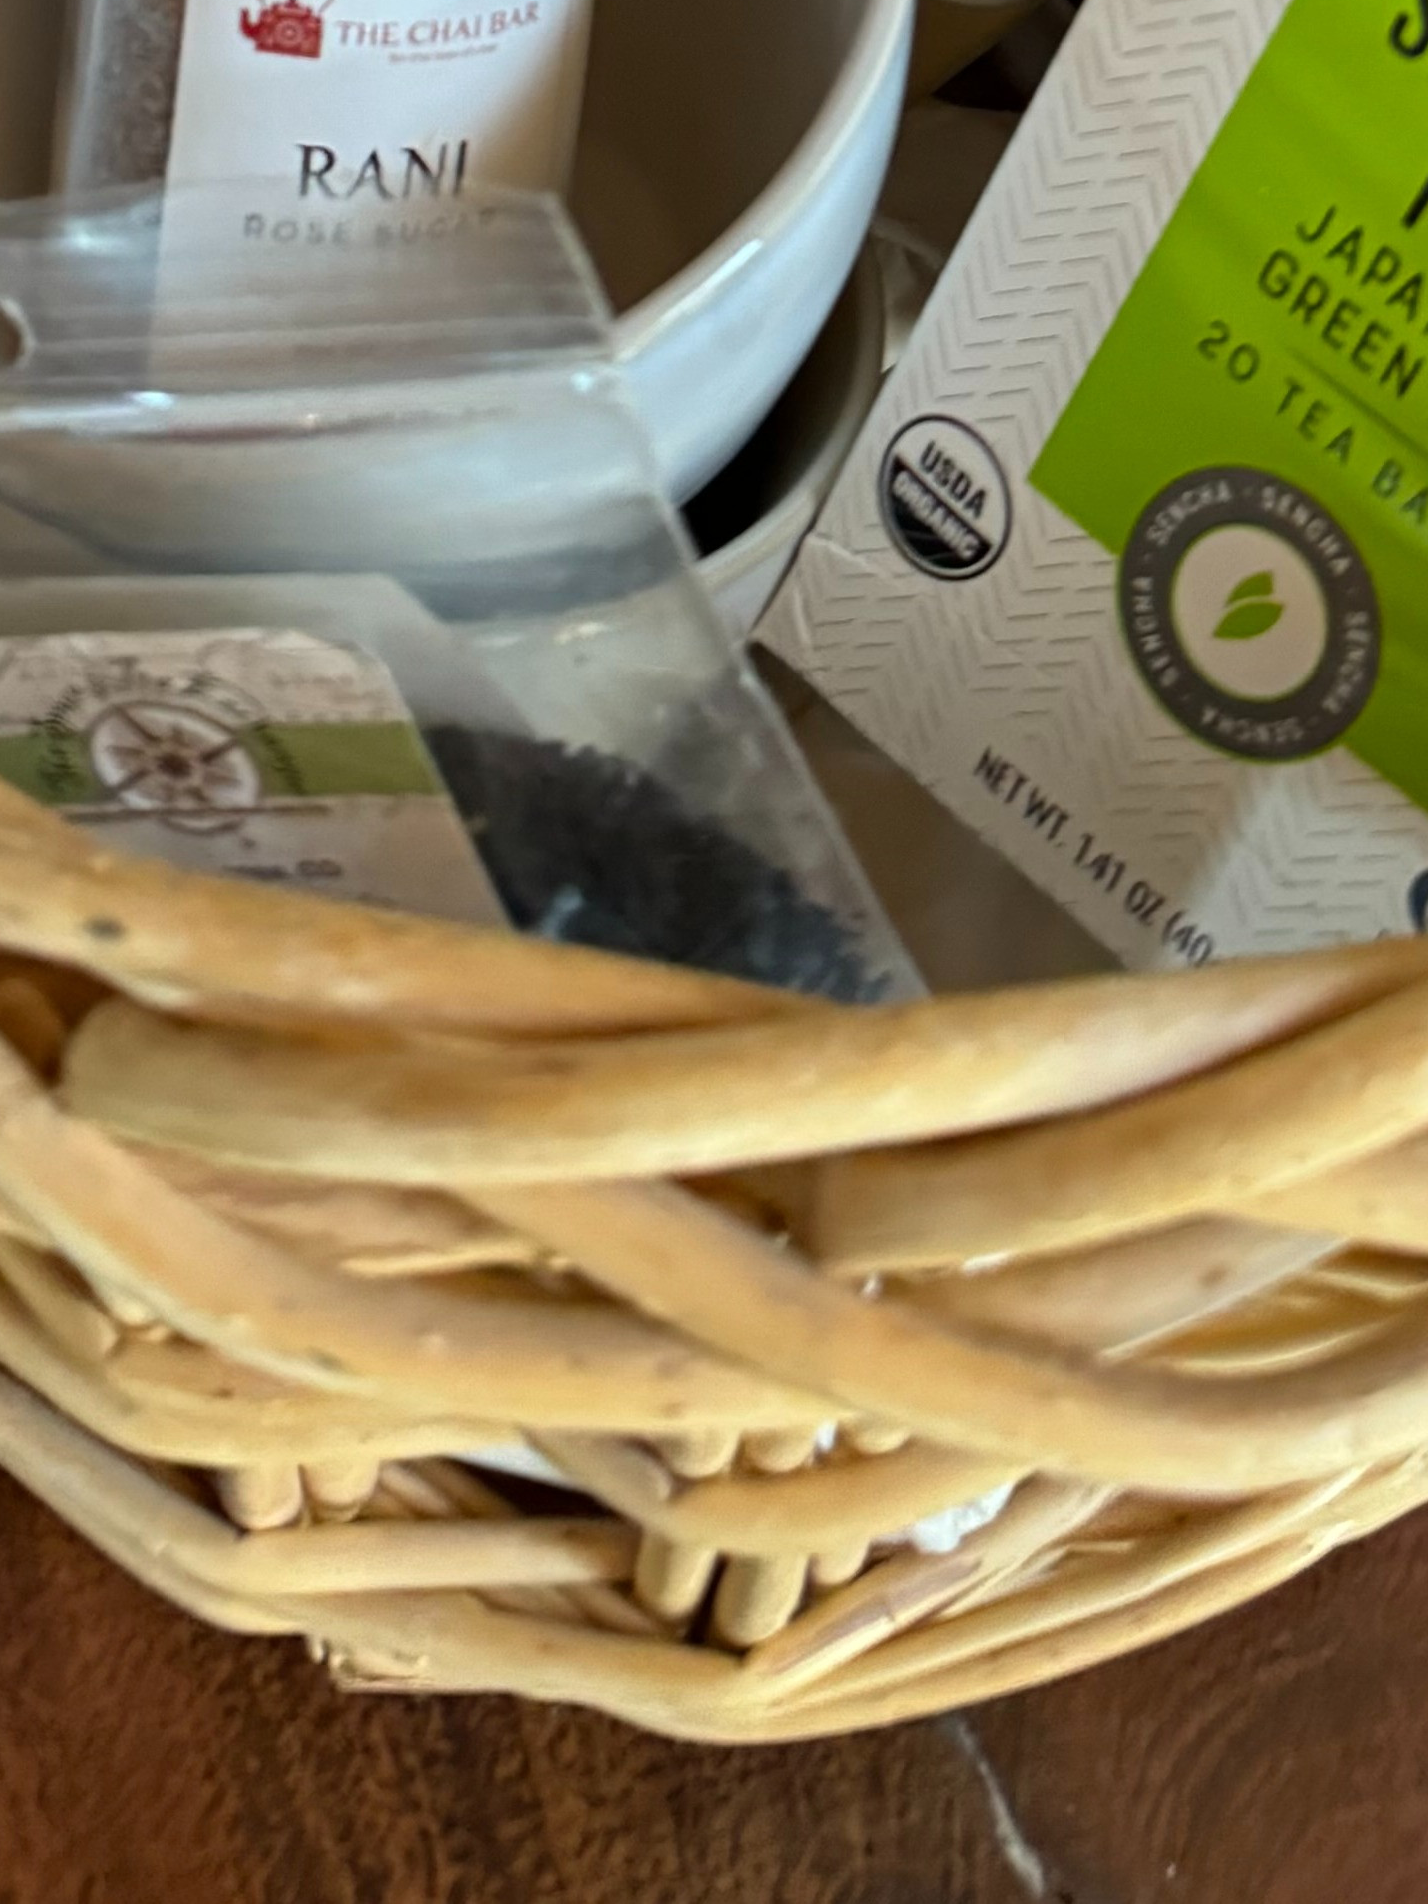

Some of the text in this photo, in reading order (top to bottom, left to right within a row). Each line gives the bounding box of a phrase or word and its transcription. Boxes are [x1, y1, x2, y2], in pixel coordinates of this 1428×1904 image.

[335, 1, 540, 46] THE CHAI BAR
[296, 139, 469, 200] RANI
[243, 212, 348, 245] ROSE
[1256, 249, 1426, 400] GREEN
[1196, 319, 1262, 384] 20
[1275, 376, 1356, 467] TEA
[890, 466, 984, 565] ORGANIC
[919, 440, 988, 522] USDA
[1146, 478, 1235, 547] SENCHA
[1258, 484, 1354, 578] SENCHA
[973, 745, 1024, 806] NET
[1024, 787, 1069, 849] WT.
[1071, 831, 1127, 894] 1.41
[1123, 879, 1166, 928] OZ
